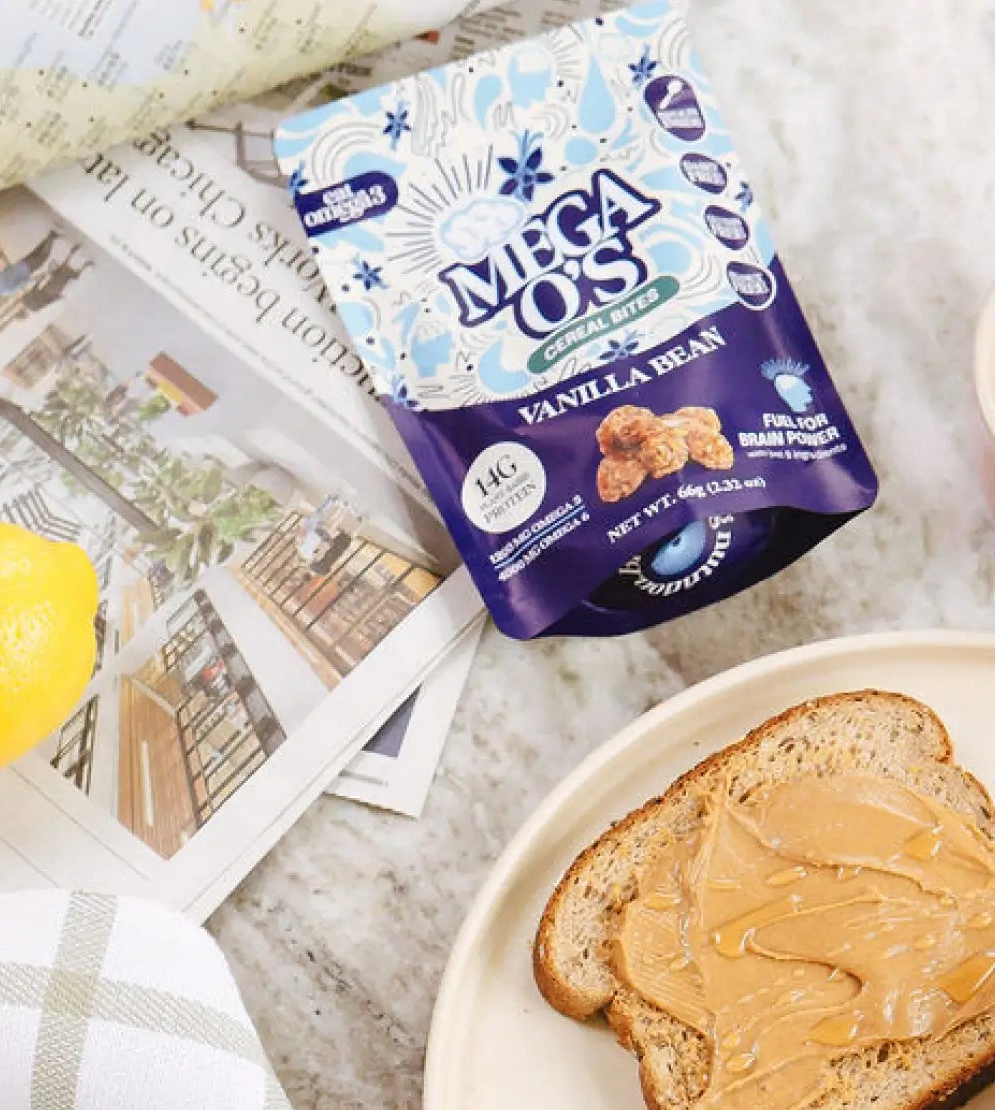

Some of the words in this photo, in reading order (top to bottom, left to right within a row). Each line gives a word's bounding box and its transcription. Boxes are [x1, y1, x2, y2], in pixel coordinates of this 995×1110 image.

[81, 152, 130, 203] lat
[131, 188, 174, 228] on
[134, 127, 247, 228] Chicag
[175, 225, 280, 324] begins
[441, 170, 660, 325] MEGA
[518, 236, 643, 334] O'S
[282, 308, 381, 402] uction
[544, 318, 610, 360] CEREAL
[610, 289, 659, 323] BITES
[518, 367, 652, 424] VANILLA
[647, 327, 726, 376] BEAN
[738, 431, 785, 447] BRAIN
[787, 426, 841, 447] POWER
[762, 413, 797, 429] FUEL
[796, 413, 829, 431] FOR
[475, 454, 517, 496] 14G
[608, 512, 641, 544] NET
[643, 493, 677, 517] WT.
[677, 484, 707, 499] 66g
